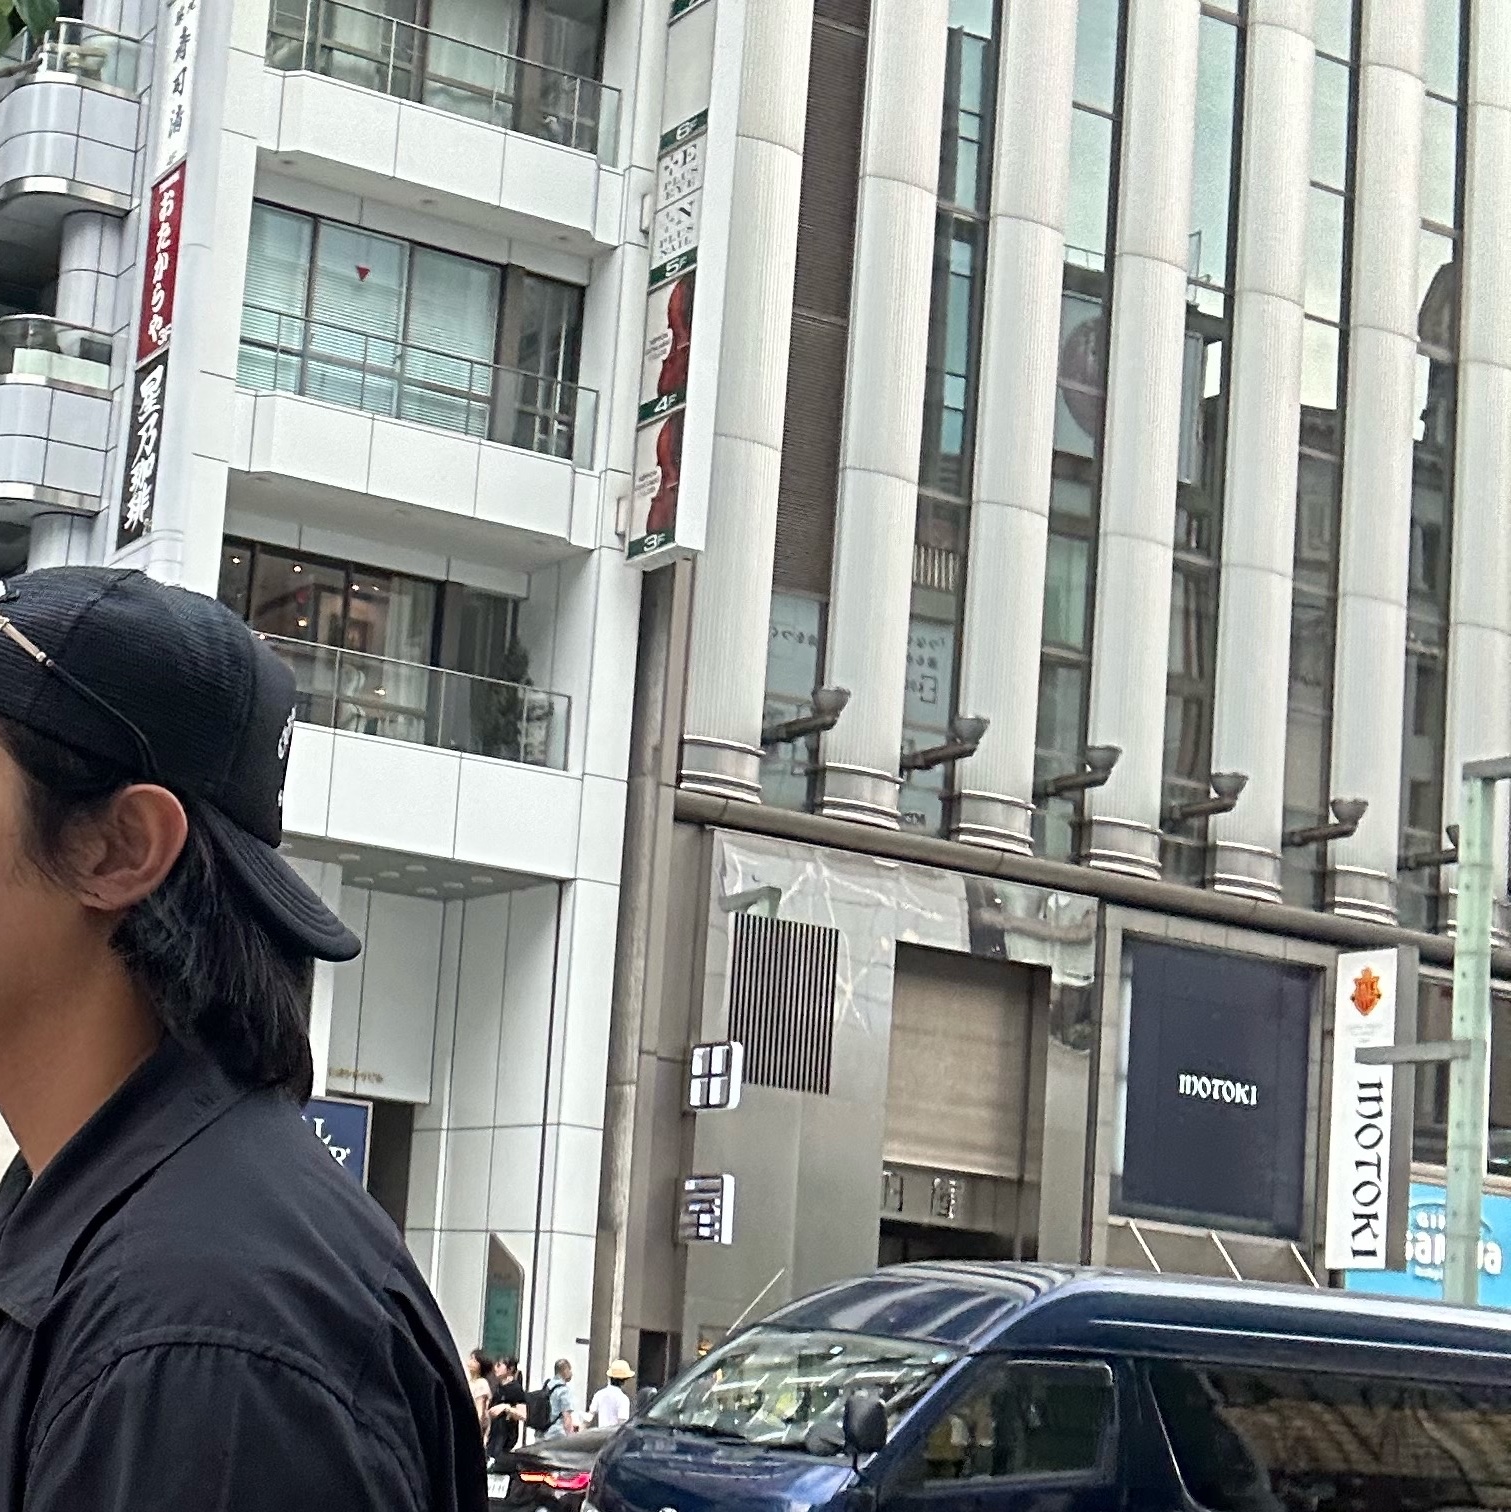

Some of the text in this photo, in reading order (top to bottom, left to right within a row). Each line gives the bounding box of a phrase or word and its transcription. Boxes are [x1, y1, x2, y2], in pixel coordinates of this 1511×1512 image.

[147, 189, 176, 343] おたからや
[123, 364, 165, 532] 星乃珈琲
[1178, 1074, 1257, 1106] MOTOKI
[1350, 1077, 1385, 1260] MOTOKI
